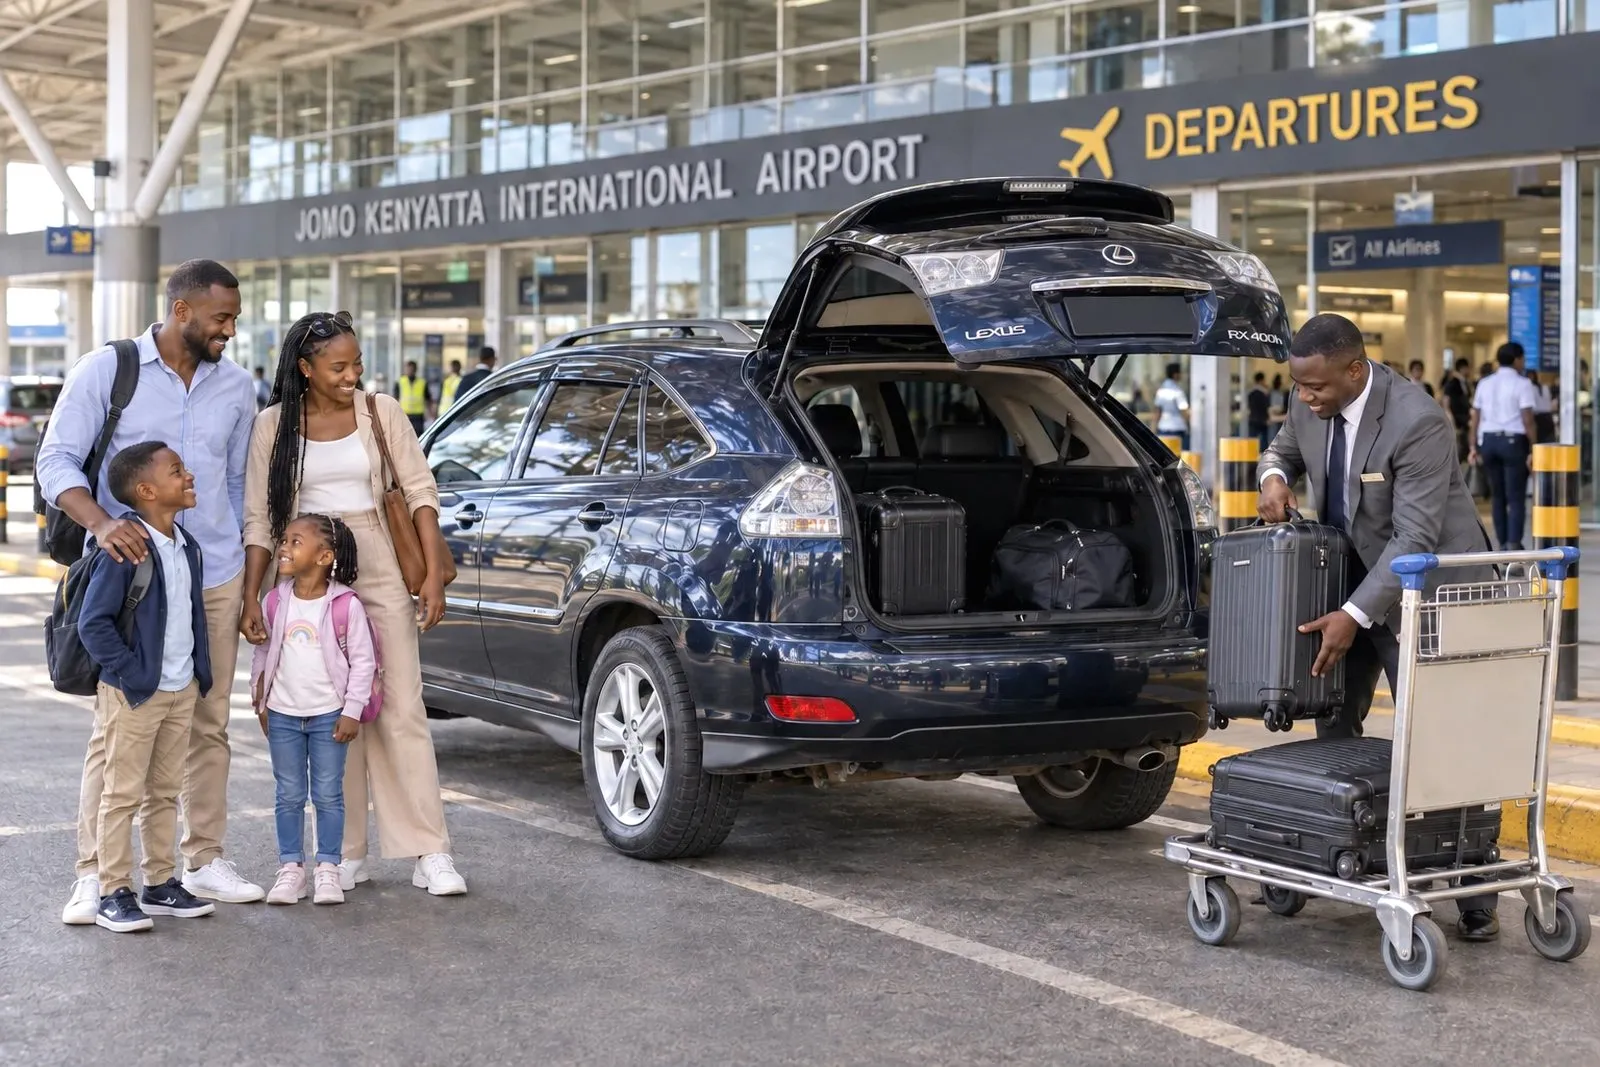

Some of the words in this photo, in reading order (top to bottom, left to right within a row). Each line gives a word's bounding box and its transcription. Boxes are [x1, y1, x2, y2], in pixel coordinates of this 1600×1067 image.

[1145, 75, 1479, 160] DEPARTURES
[295, 204, 356, 242] JOMO
[364, 189, 486, 235] KENYATTA
[500, 158, 733, 222] INTERNATIONAL
[756, 134, 923, 195] AIRPORT
[1364, 240, 1383, 258] All
[1385, 238, 1441, 257] Airlines
[965, 325, 1026, 340] LEXUS
[1227, 329, 1250, 341] RX
[1250, 332, 1283, 345] 400h
